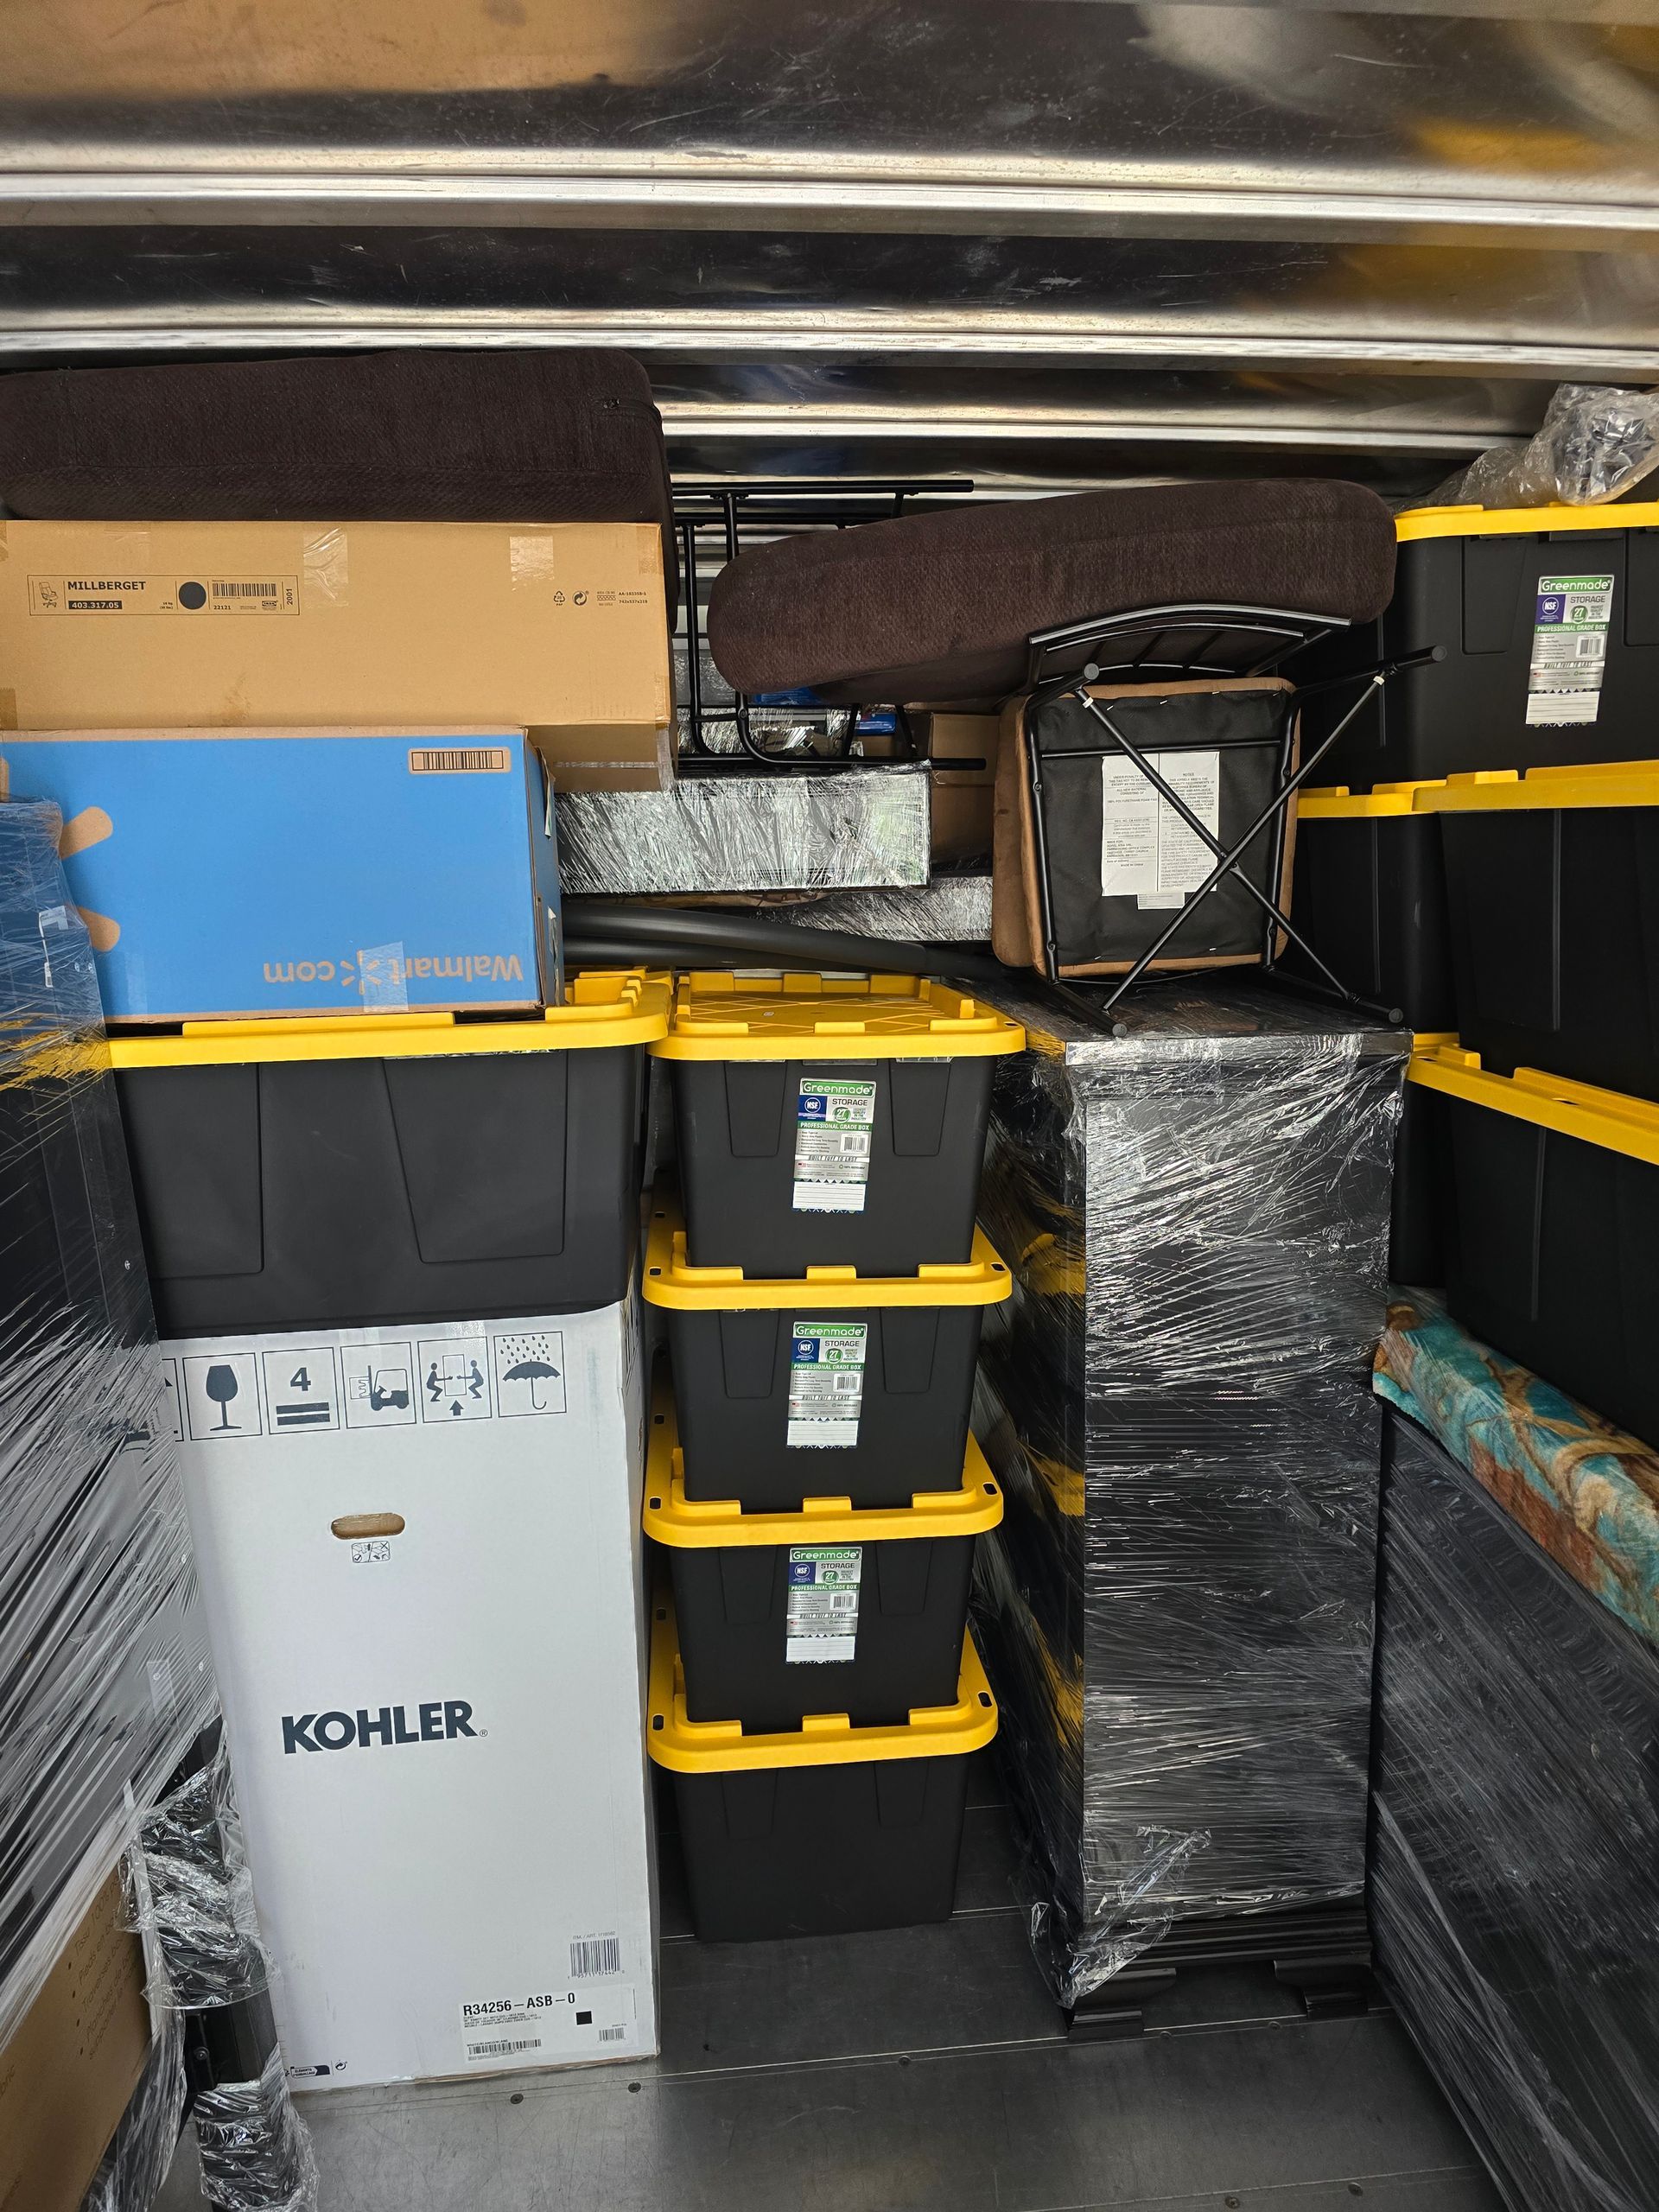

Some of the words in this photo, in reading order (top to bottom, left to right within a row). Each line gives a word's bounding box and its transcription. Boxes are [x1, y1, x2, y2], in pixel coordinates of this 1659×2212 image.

[67, 581, 146, 590] MILLBERGET
[1541, 580, 1608, 591] Greenmade
[1544, 601, 1557, 610] NSF
[1574, 607, 1584, 617] 27
[388, 954, 524, 985] Walmart
[804, 1083, 870, 1095] Greenmade
[797, 1325, 861, 1336] Greenmade
[289, 1366, 312, 1392] 4
[793, 1550, 856, 1560] Greenmade
[282, 1700, 478, 1754] KOHLER
